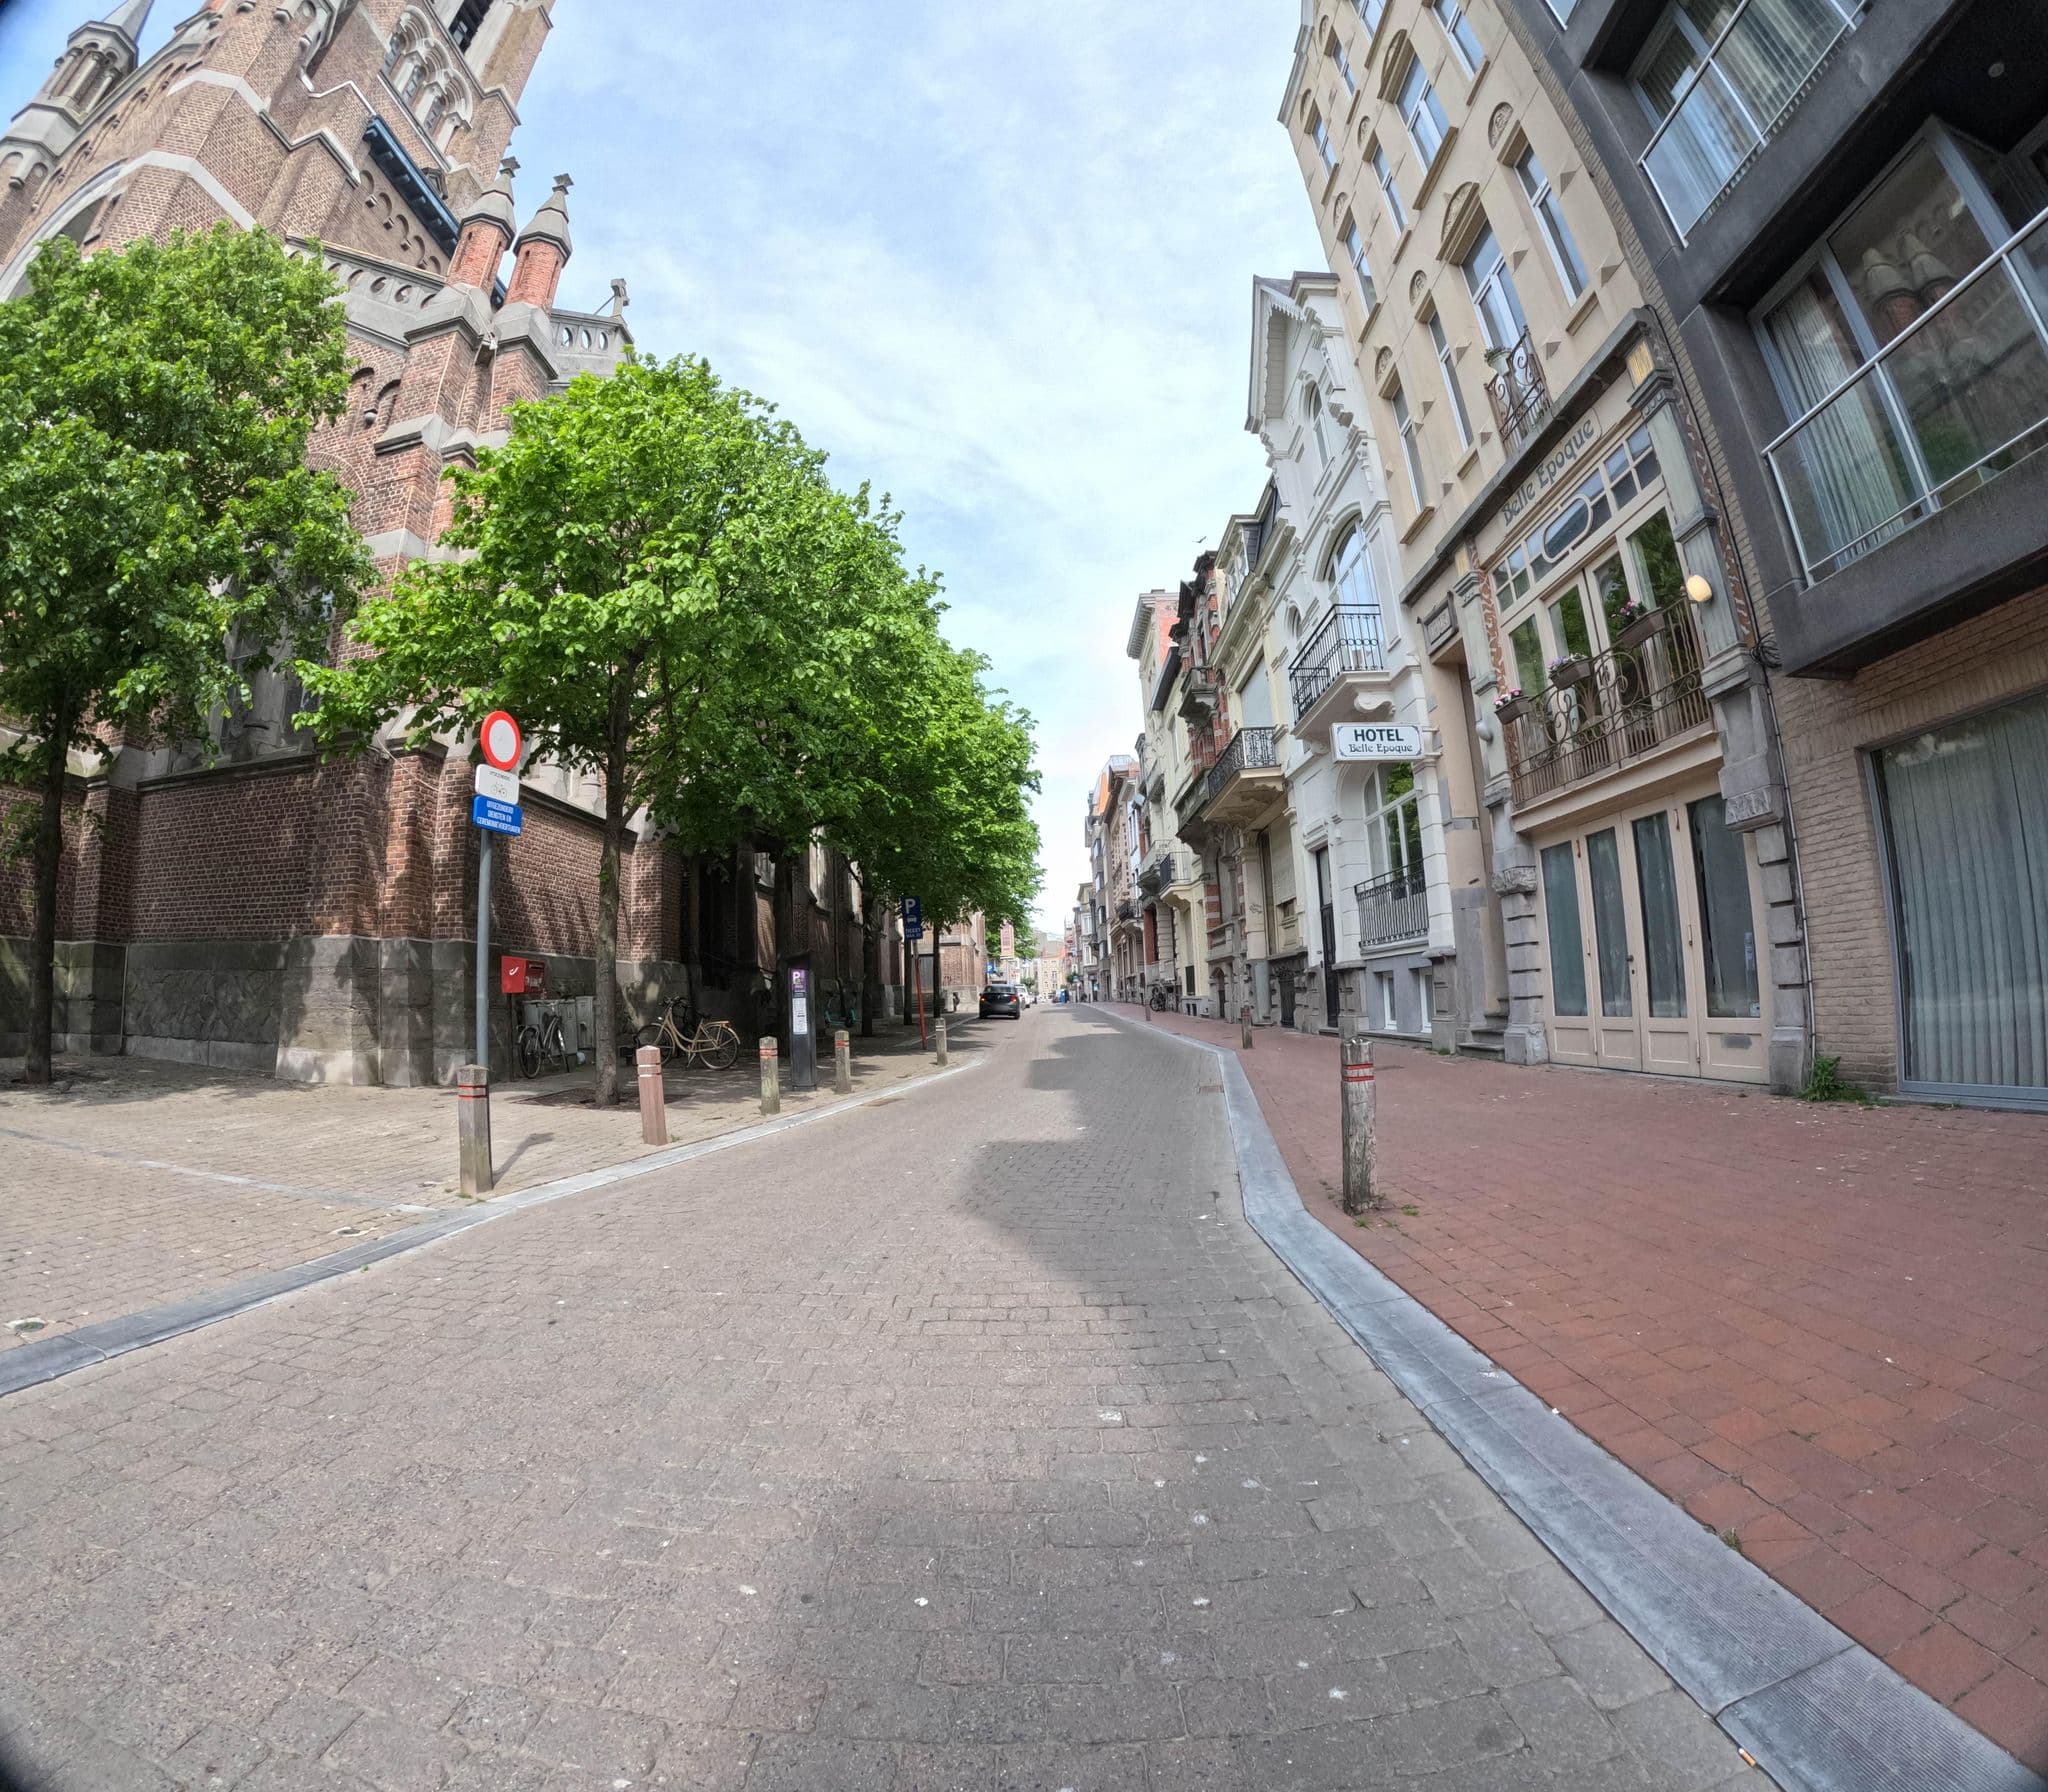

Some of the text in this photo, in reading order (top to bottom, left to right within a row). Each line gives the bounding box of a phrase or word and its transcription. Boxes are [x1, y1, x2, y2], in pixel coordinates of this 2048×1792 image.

[1501, 419, 1595, 526] Belle Epoque
[1354, 729, 1404, 742] HOTEL
[1348, 743, 1413, 754] Belle Epoque
[905, 898, 916, 914] P
